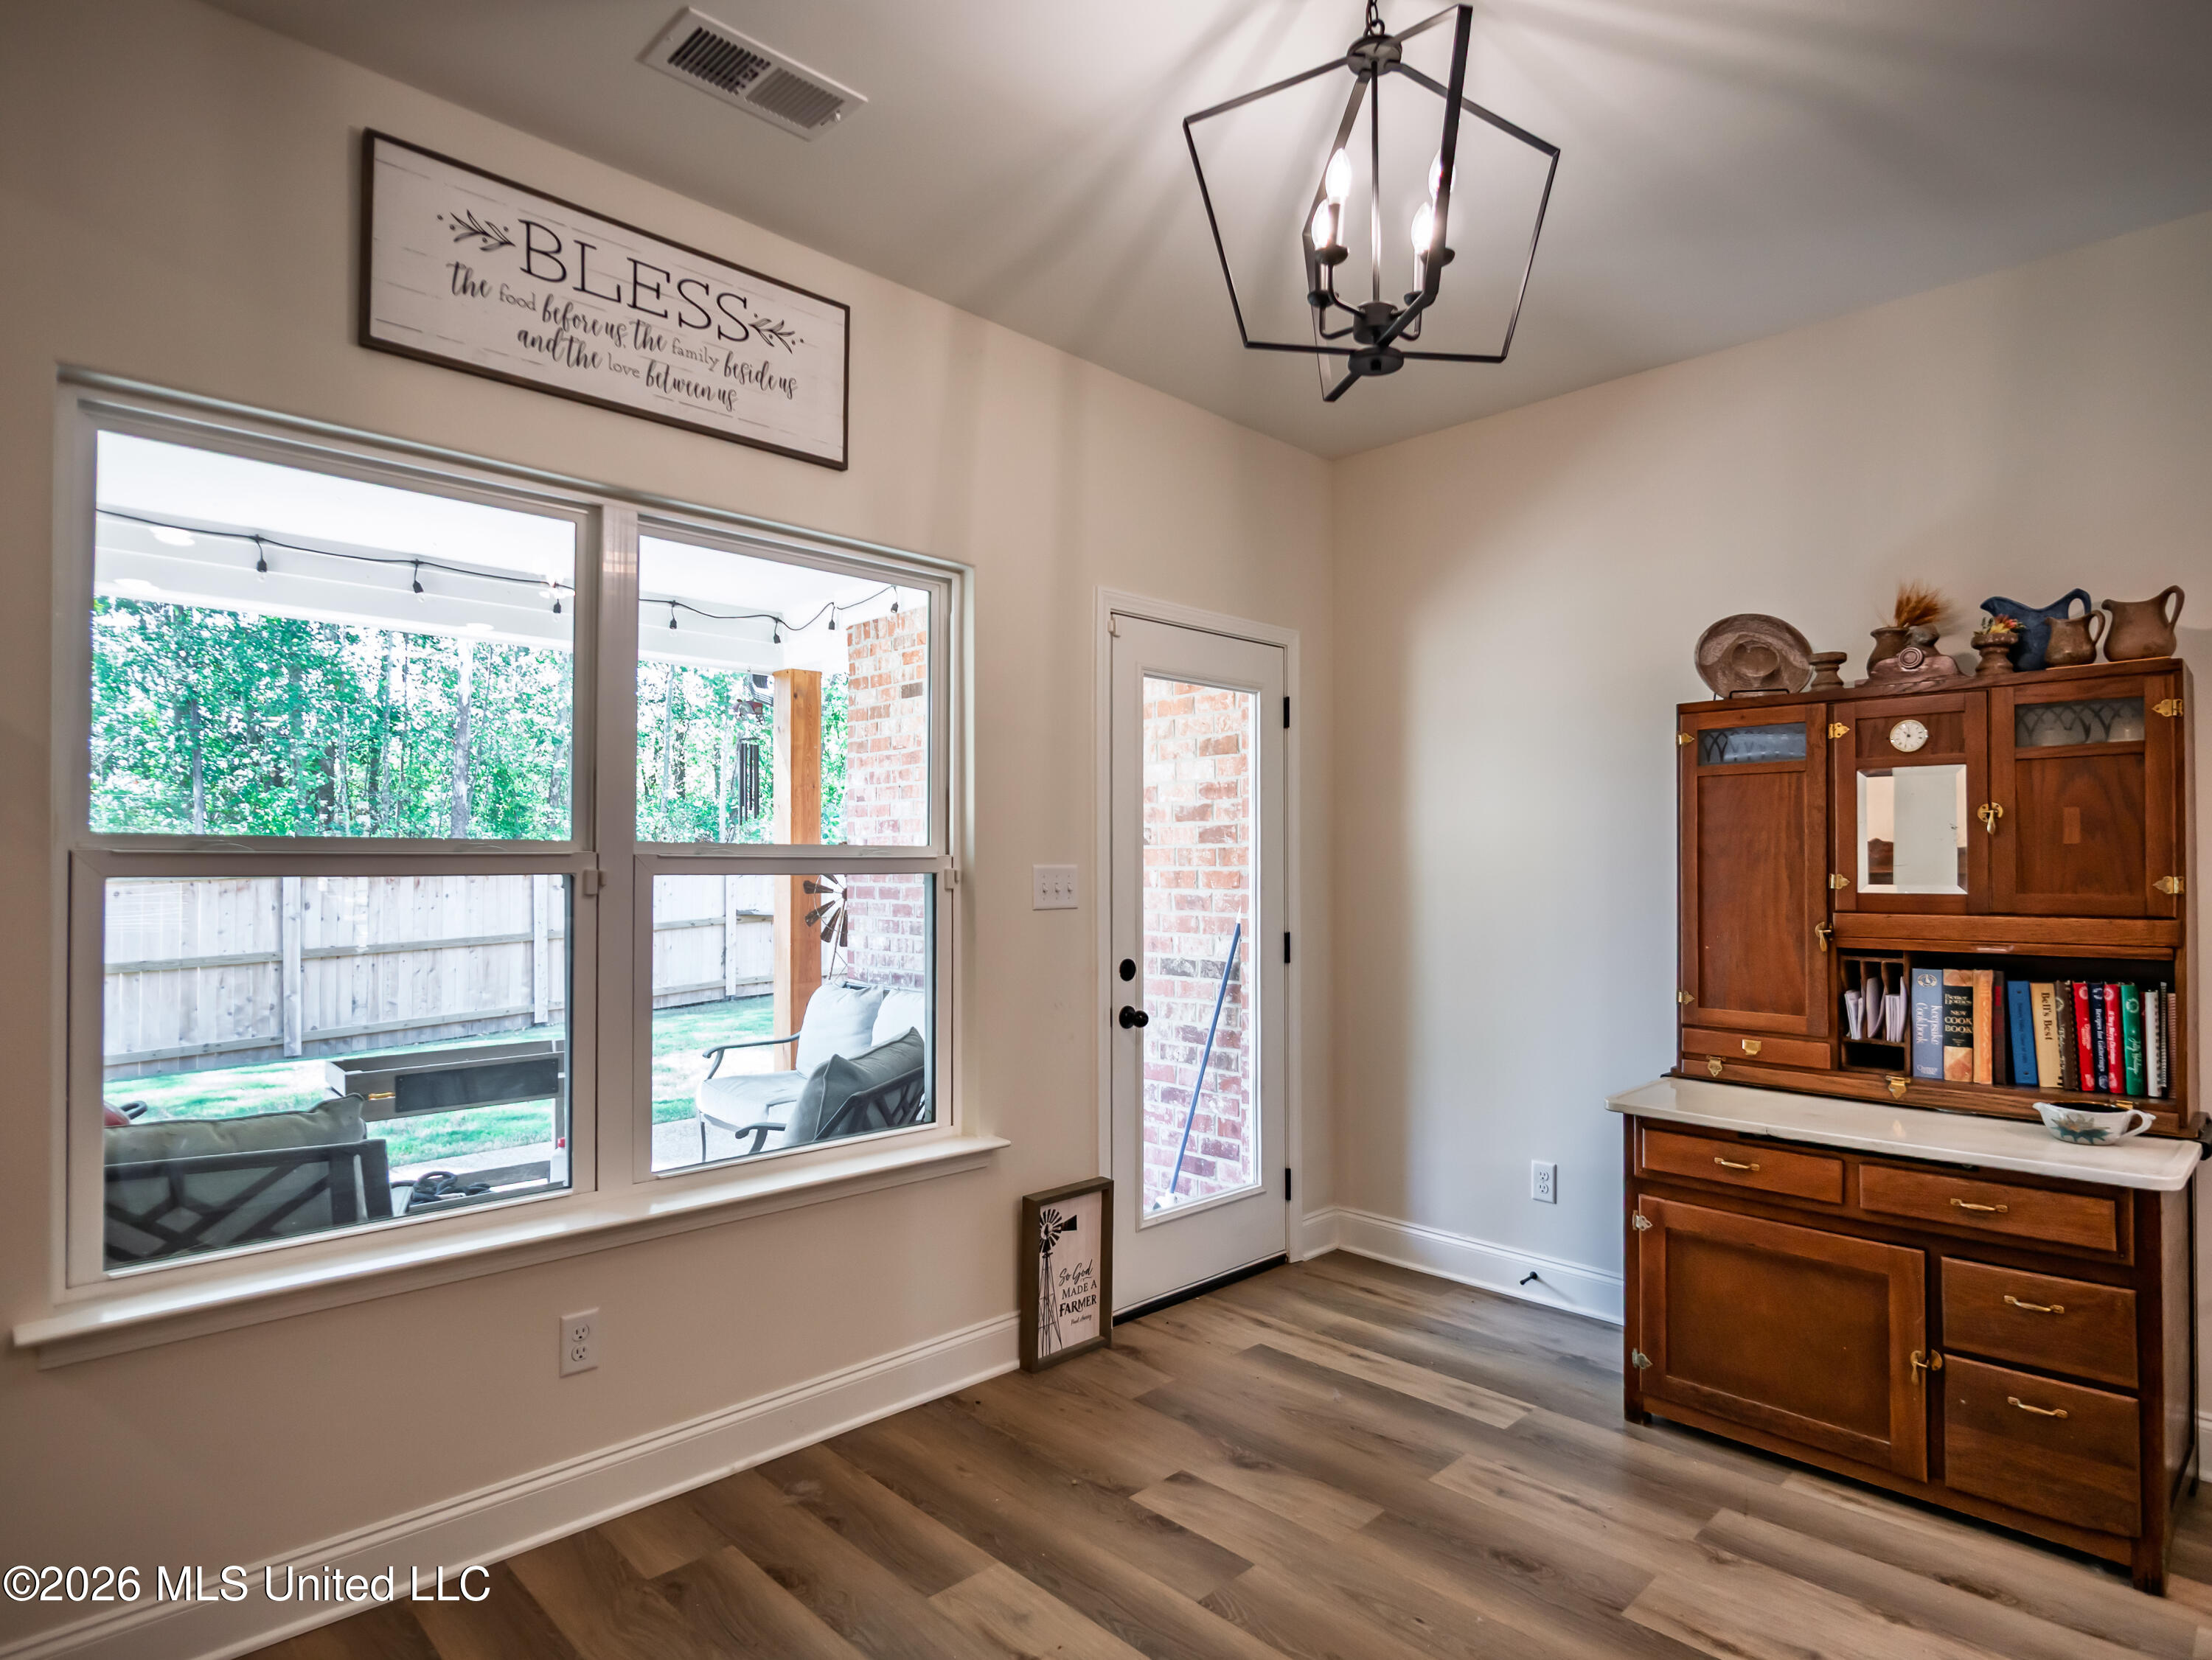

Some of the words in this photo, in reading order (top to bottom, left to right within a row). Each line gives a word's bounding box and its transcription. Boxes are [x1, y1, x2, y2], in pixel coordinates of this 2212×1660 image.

[518, 219, 750, 343] BLESS
[445, 261, 492, 298] the
[499, 282, 538, 312] food
[542, 293, 603, 337] before
[629, 318, 667, 352] the
[672, 337, 720, 372] family
[723, 350, 779, 391] beside
[779, 376, 798, 400] us
[518, 327, 565, 361] and
[562, 335, 602, 369] the
[608, 352, 640, 379] love
[646, 359, 717, 402] between
[2041, 992, 2051, 1016] Bell's
[1916, 1002, 1928, 1044] Cookbook
[1927, 1005, 1943, 1045] Keepsake
[1944, 1016, 1972, 1025] COOK
[1944, 1025, 1973, 1033] BOOK
[2043, 1020, 2053, 1040] Best
[1059, 1268, 1071, 1286] So
[1072, 1258, 1093, 1285] God
[1062, 1283, 1088, 1300] MADE
[1091, 1280, 1097, 1289] A
[1060, 1294, 1097, 1317] FARMER
